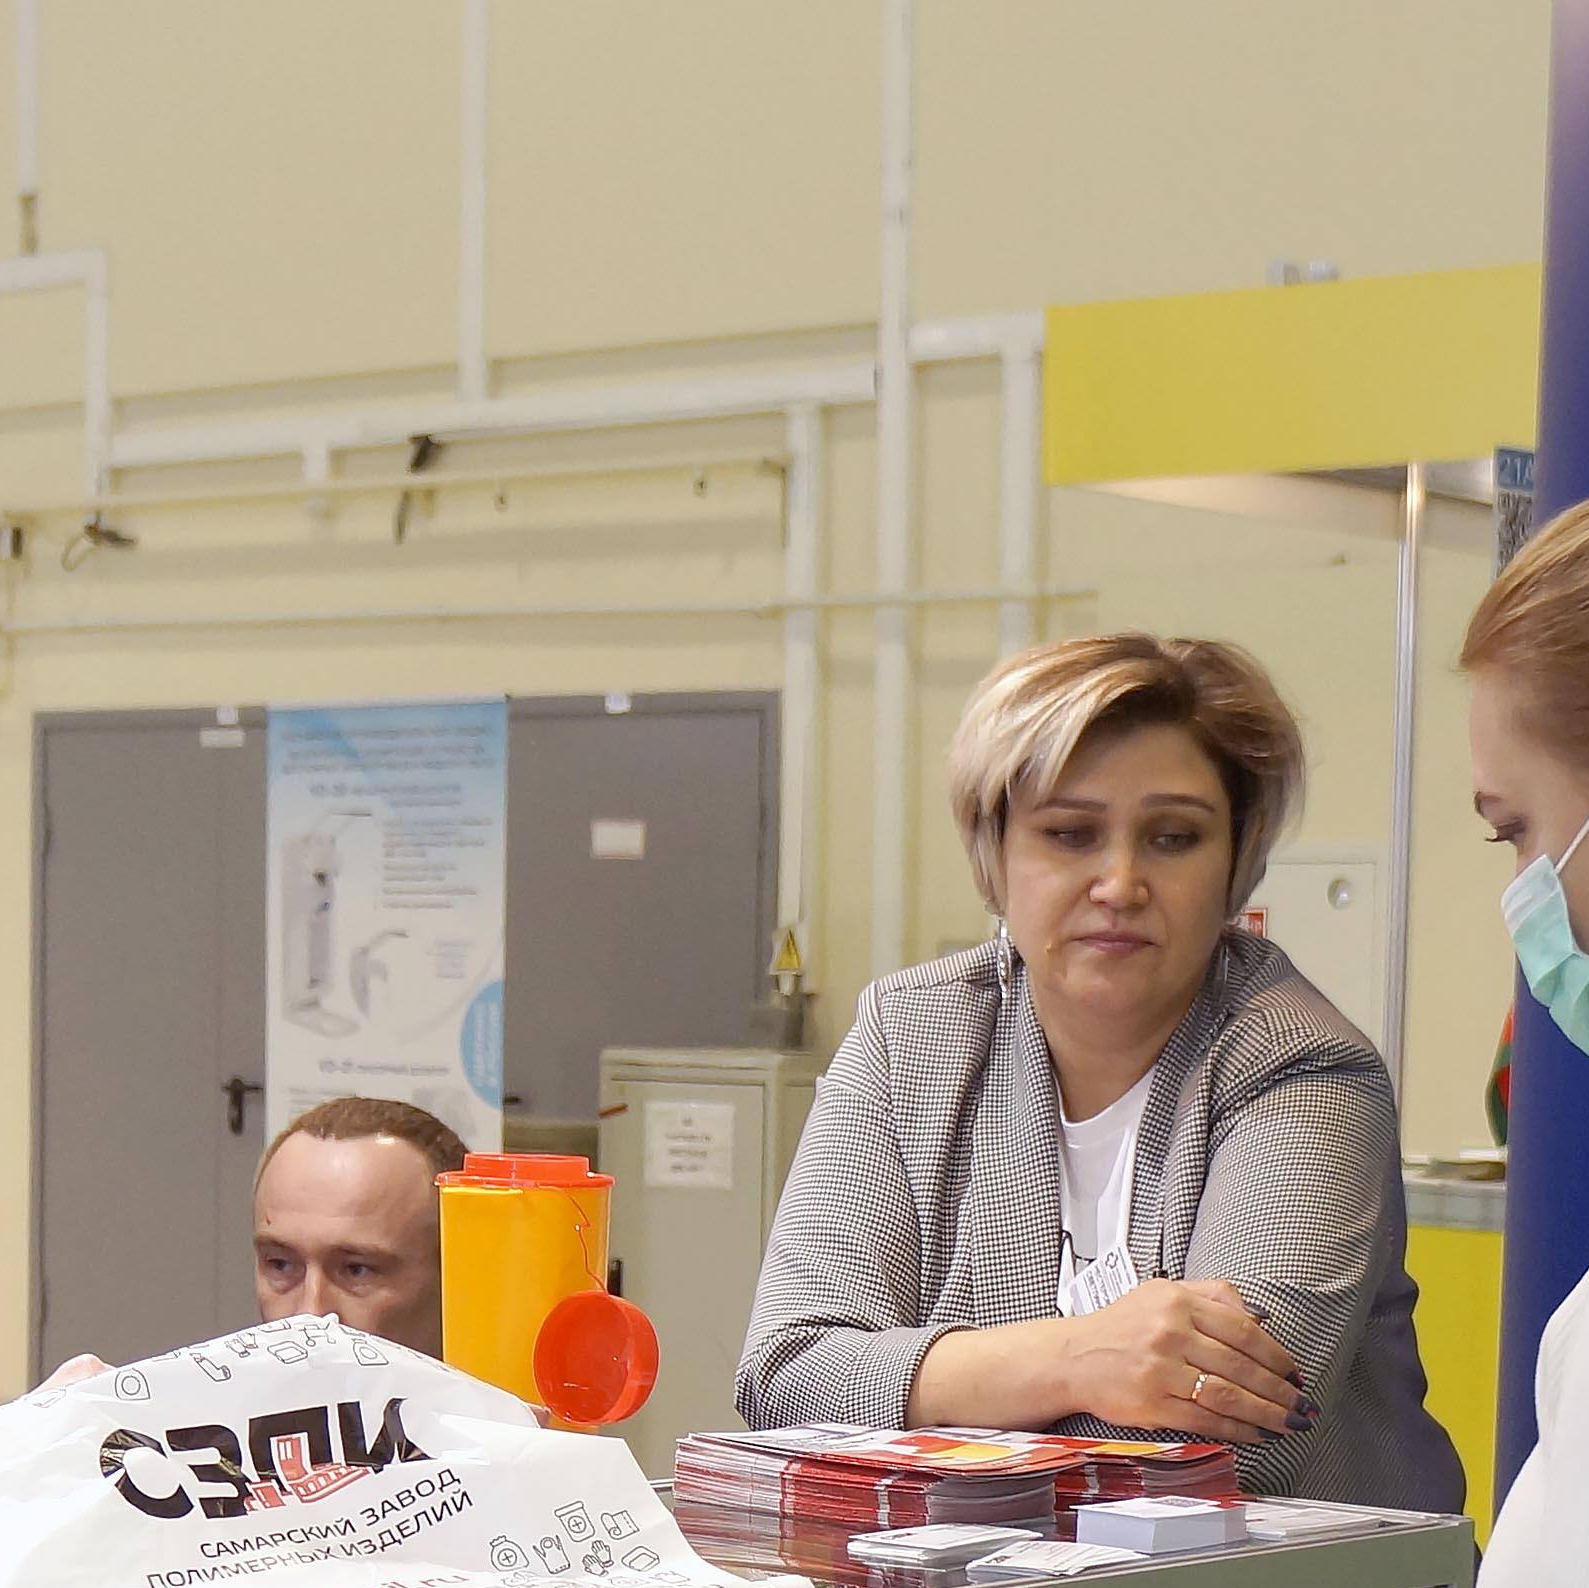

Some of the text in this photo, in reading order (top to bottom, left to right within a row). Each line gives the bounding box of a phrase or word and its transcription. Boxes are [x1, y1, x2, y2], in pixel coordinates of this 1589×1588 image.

[99, 1397, 437, 1520] СЗПИ
[199, 1468, 462, 1560] САМАРСКИЙ ЗАВОД
[338, 1488, 474, 1557] ИЗДЕЛИЙ
